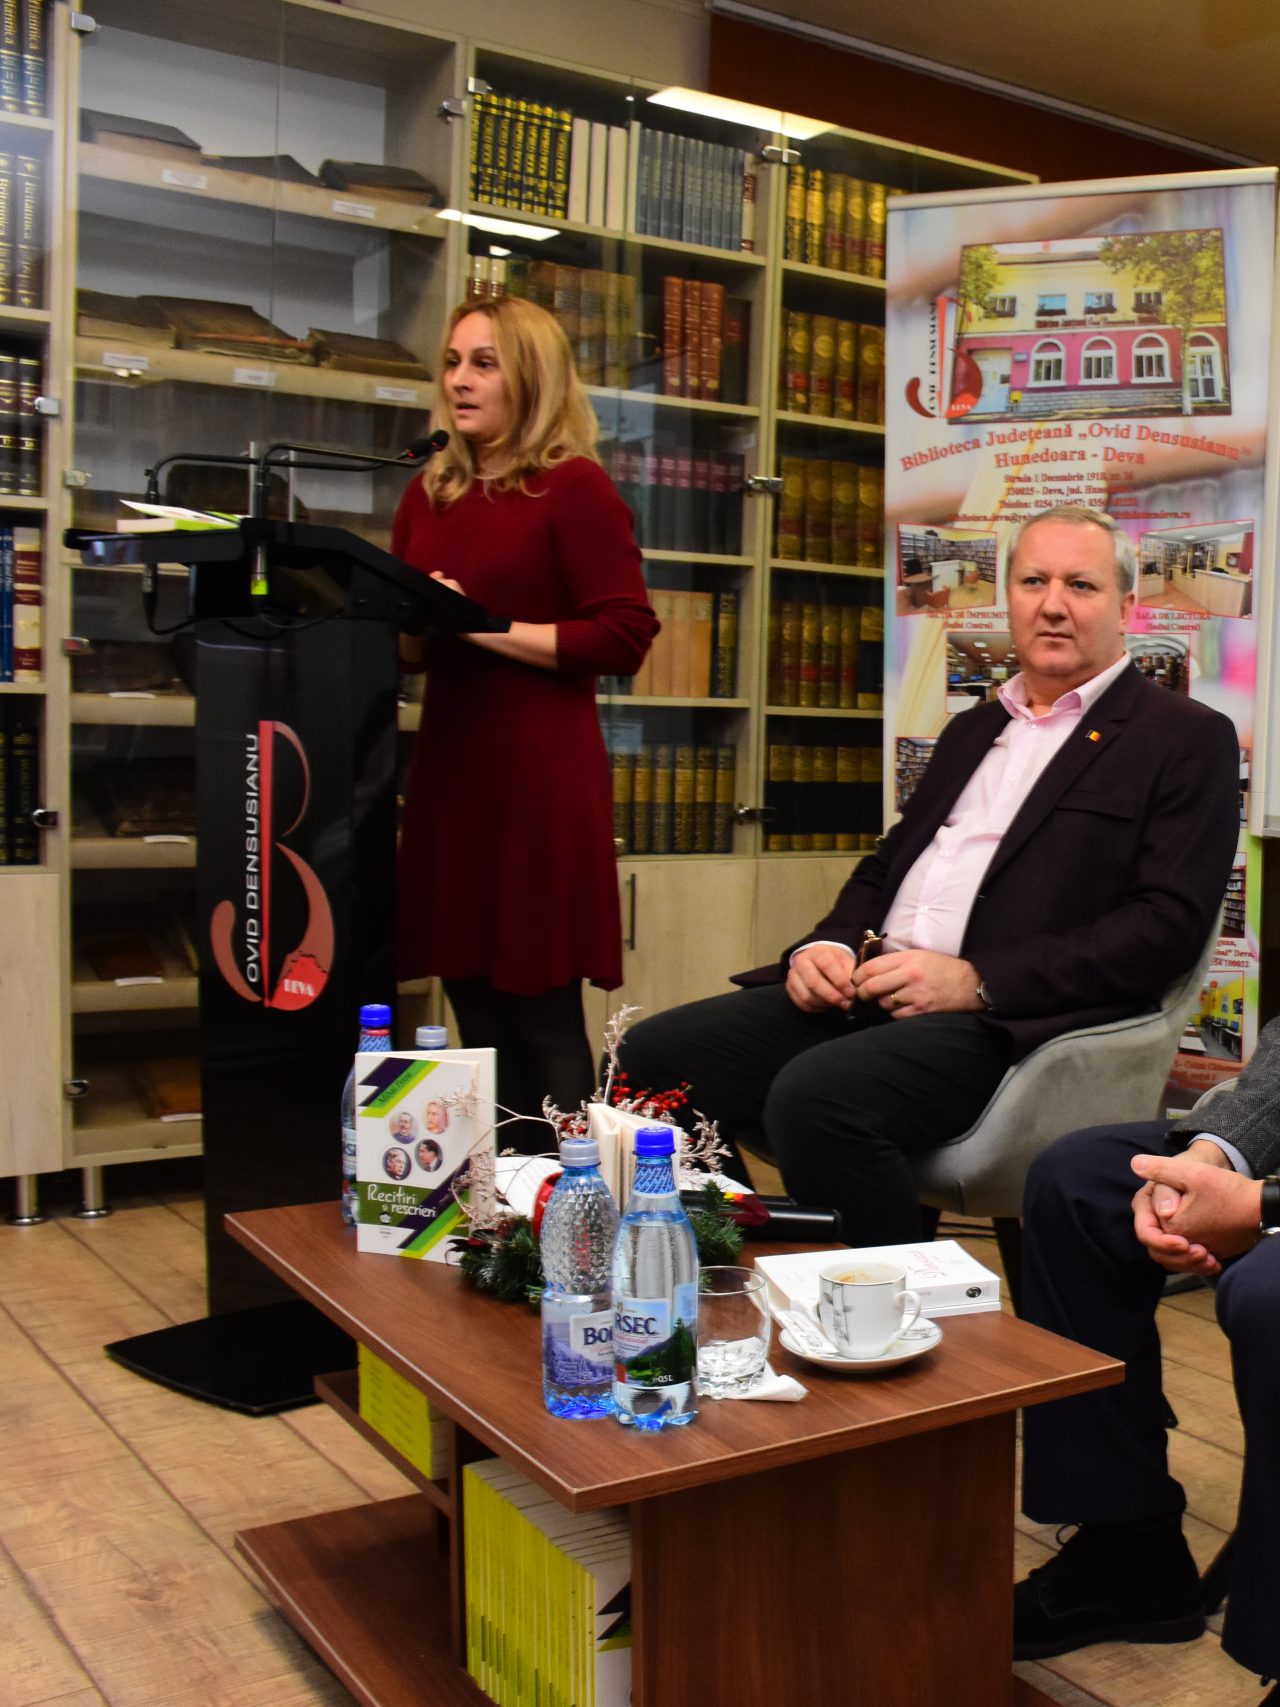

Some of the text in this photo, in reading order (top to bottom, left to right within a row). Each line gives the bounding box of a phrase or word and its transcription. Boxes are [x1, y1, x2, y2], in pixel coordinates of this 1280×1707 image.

[900, 436, 981, 472] Biblioteca
[994, 448, 1087, 469] Hunedoara
[1103, 446, 1146, 464] Deva
[246, 734, 260, 983] OVID DENSUSIANU
[367, 1183, 417, 1206] Recitiri
[390, 1203, 437, 1218] rescrieri
